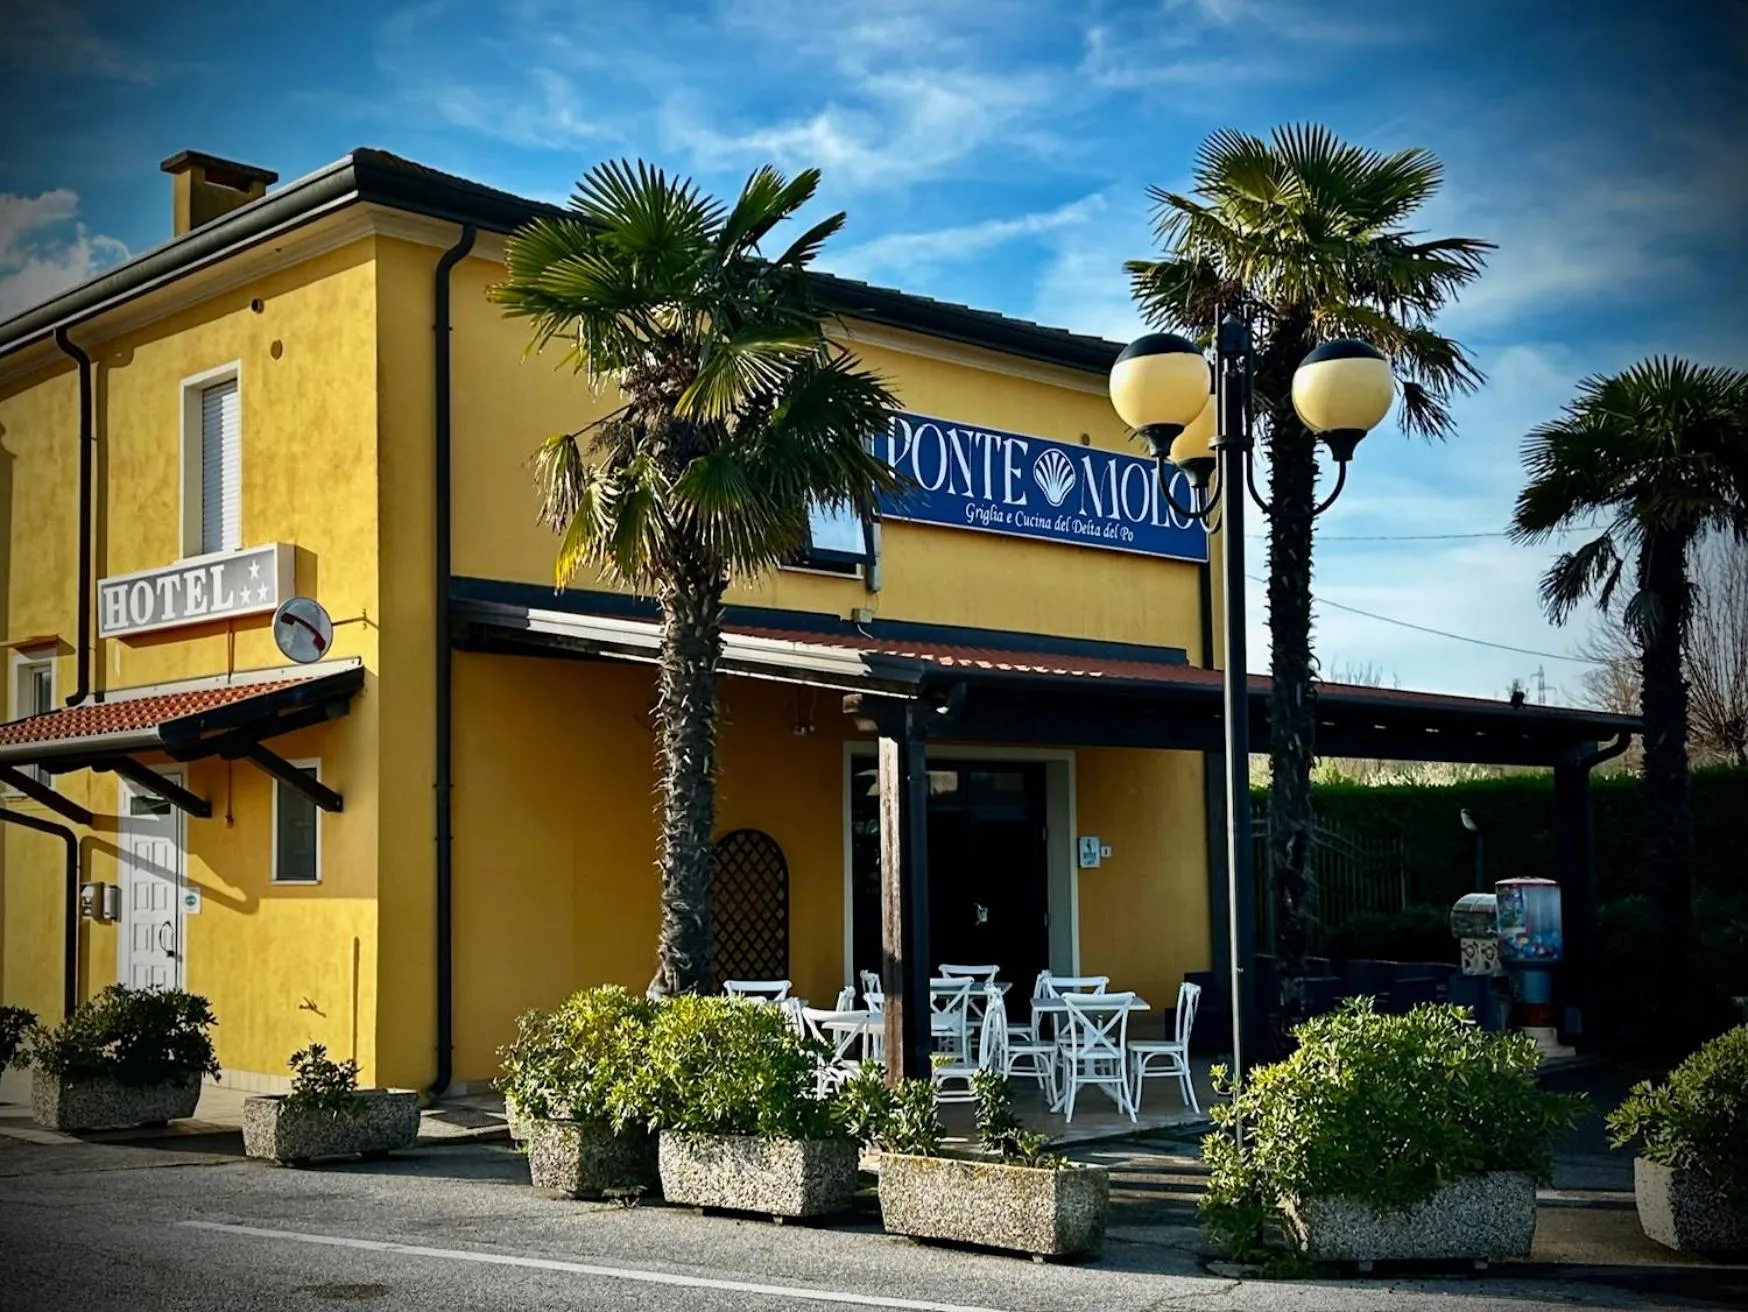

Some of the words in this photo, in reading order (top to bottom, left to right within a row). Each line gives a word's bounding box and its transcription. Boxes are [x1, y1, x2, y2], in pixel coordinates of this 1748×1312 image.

[888, 416, 1028, 505] PONTE
[1079, 456, 1196, 530] MOLO
[966, 503, 1003, 526] Griglia
[1006, 512, 1013, 524] e
[1015, 511, 1051, 529] Cucina
[1054, 515, 1071, 532] del
[1072, 519, 1101, 537] Delta
[1103, 522, 1119, 539] del
[1120, 526, 1134, 542] Po
[103, 564, 234, 630] HOTEL
